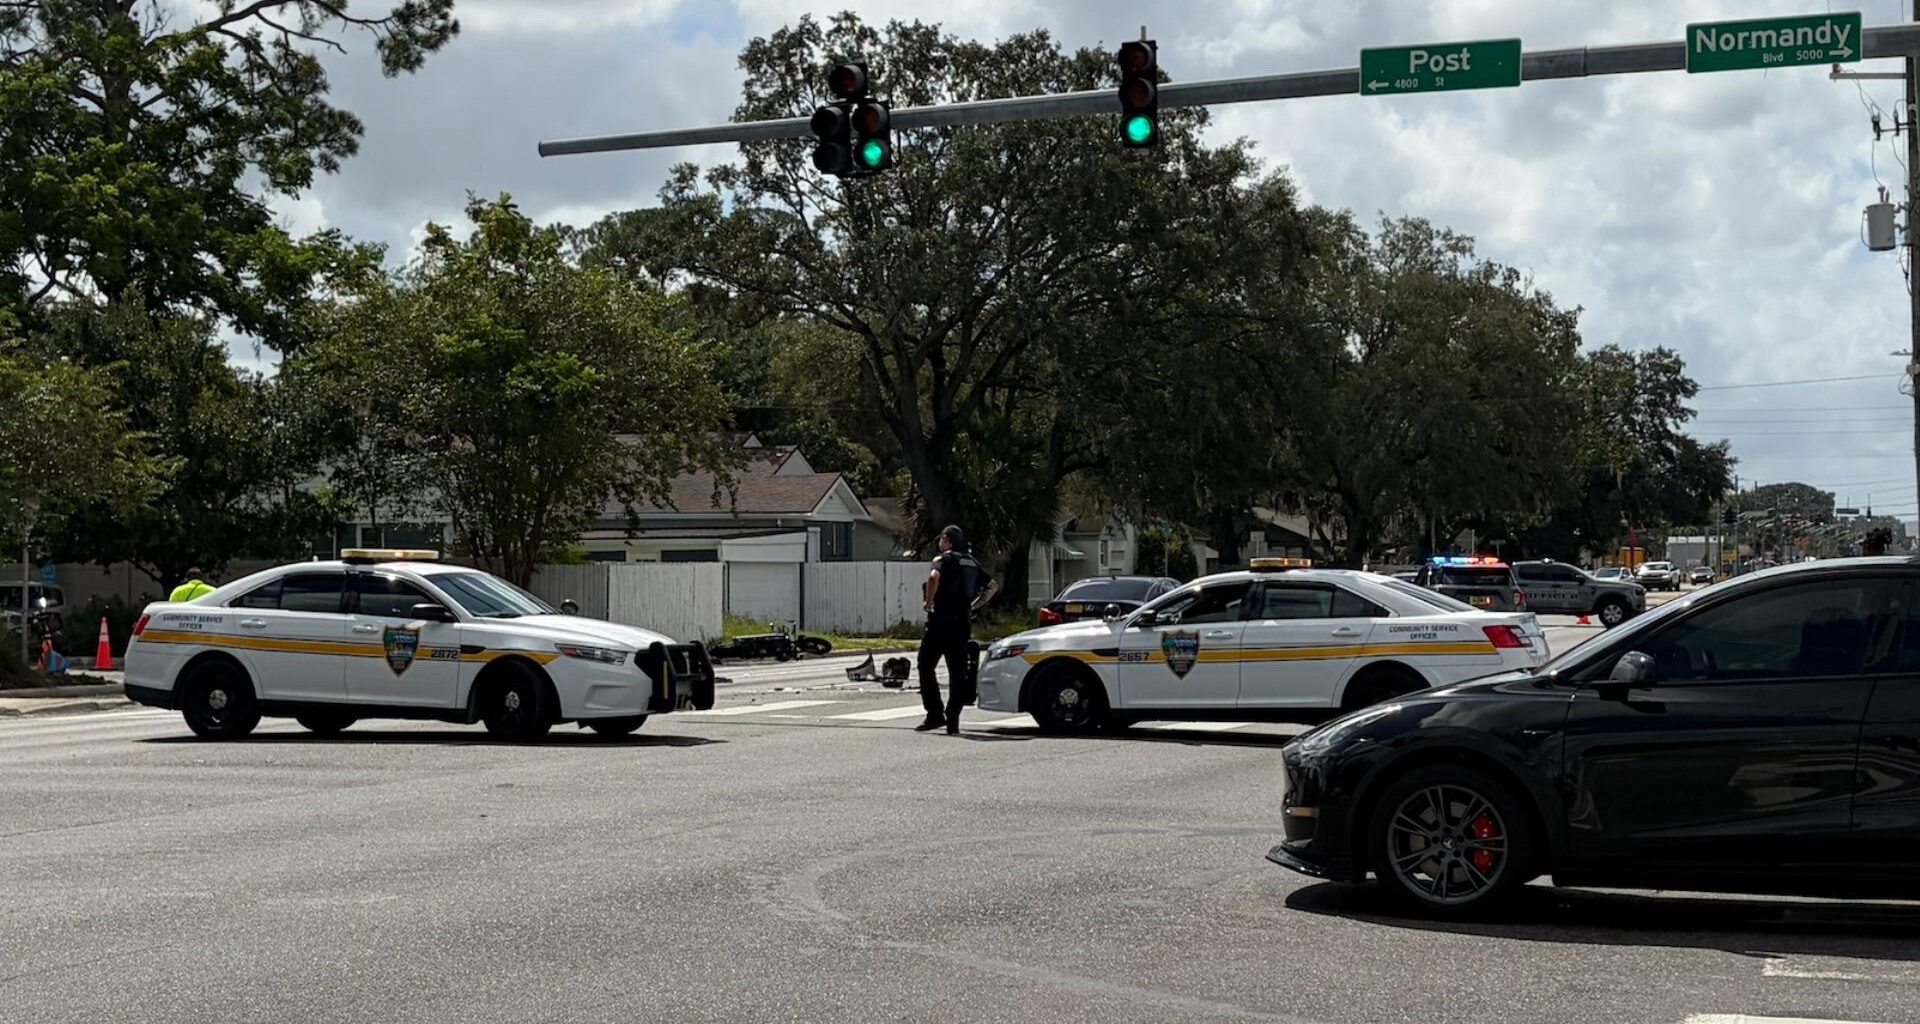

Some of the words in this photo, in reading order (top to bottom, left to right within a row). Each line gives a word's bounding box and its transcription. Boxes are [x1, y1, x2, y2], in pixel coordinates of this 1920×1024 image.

[1696, 19, 1852, 53] Normandy
[1409, 47, 1471, 74] Post
[1762, 52, 1784, 63] Blvd
[1796, 49, 1823, 61] 5000
[1395, 78, 1418, 89] 4800
[1435, 76, 1444, 87] St
[198, 615, 223, 623] SERVICE
[1389, 625, 1429, 633] COMMUNITY
[1431, 624, 1458, 632] SERVICE
[1410, 632, 1437, 640] OFFICER
